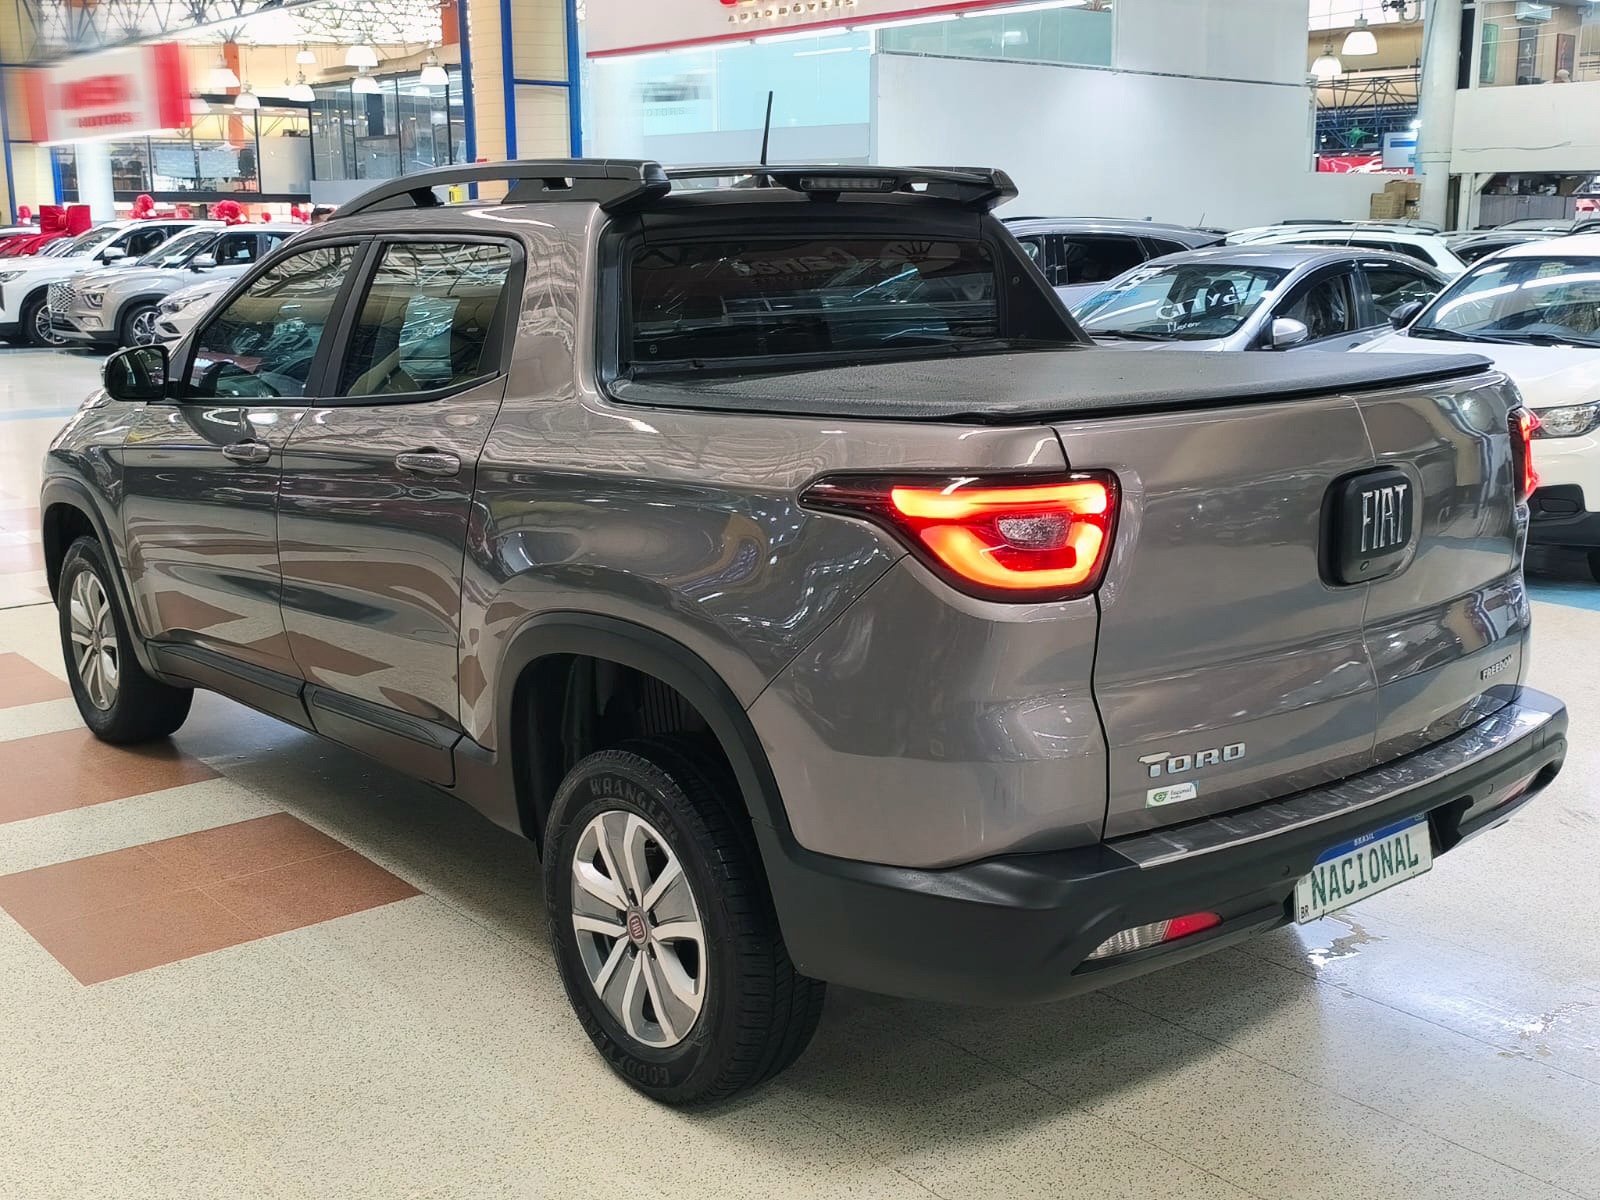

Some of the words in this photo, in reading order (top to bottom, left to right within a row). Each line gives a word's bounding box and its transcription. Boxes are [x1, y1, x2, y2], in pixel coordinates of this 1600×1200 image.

[1361, 484, 1407, 552] FIAT
[1138, 742, 1246, 778] TORO
[1353, 832, 1375, 847] BRASIL
[1311, 834, 1419, 910] NACIONAL
[1300, 904, 1310, 919] BR
